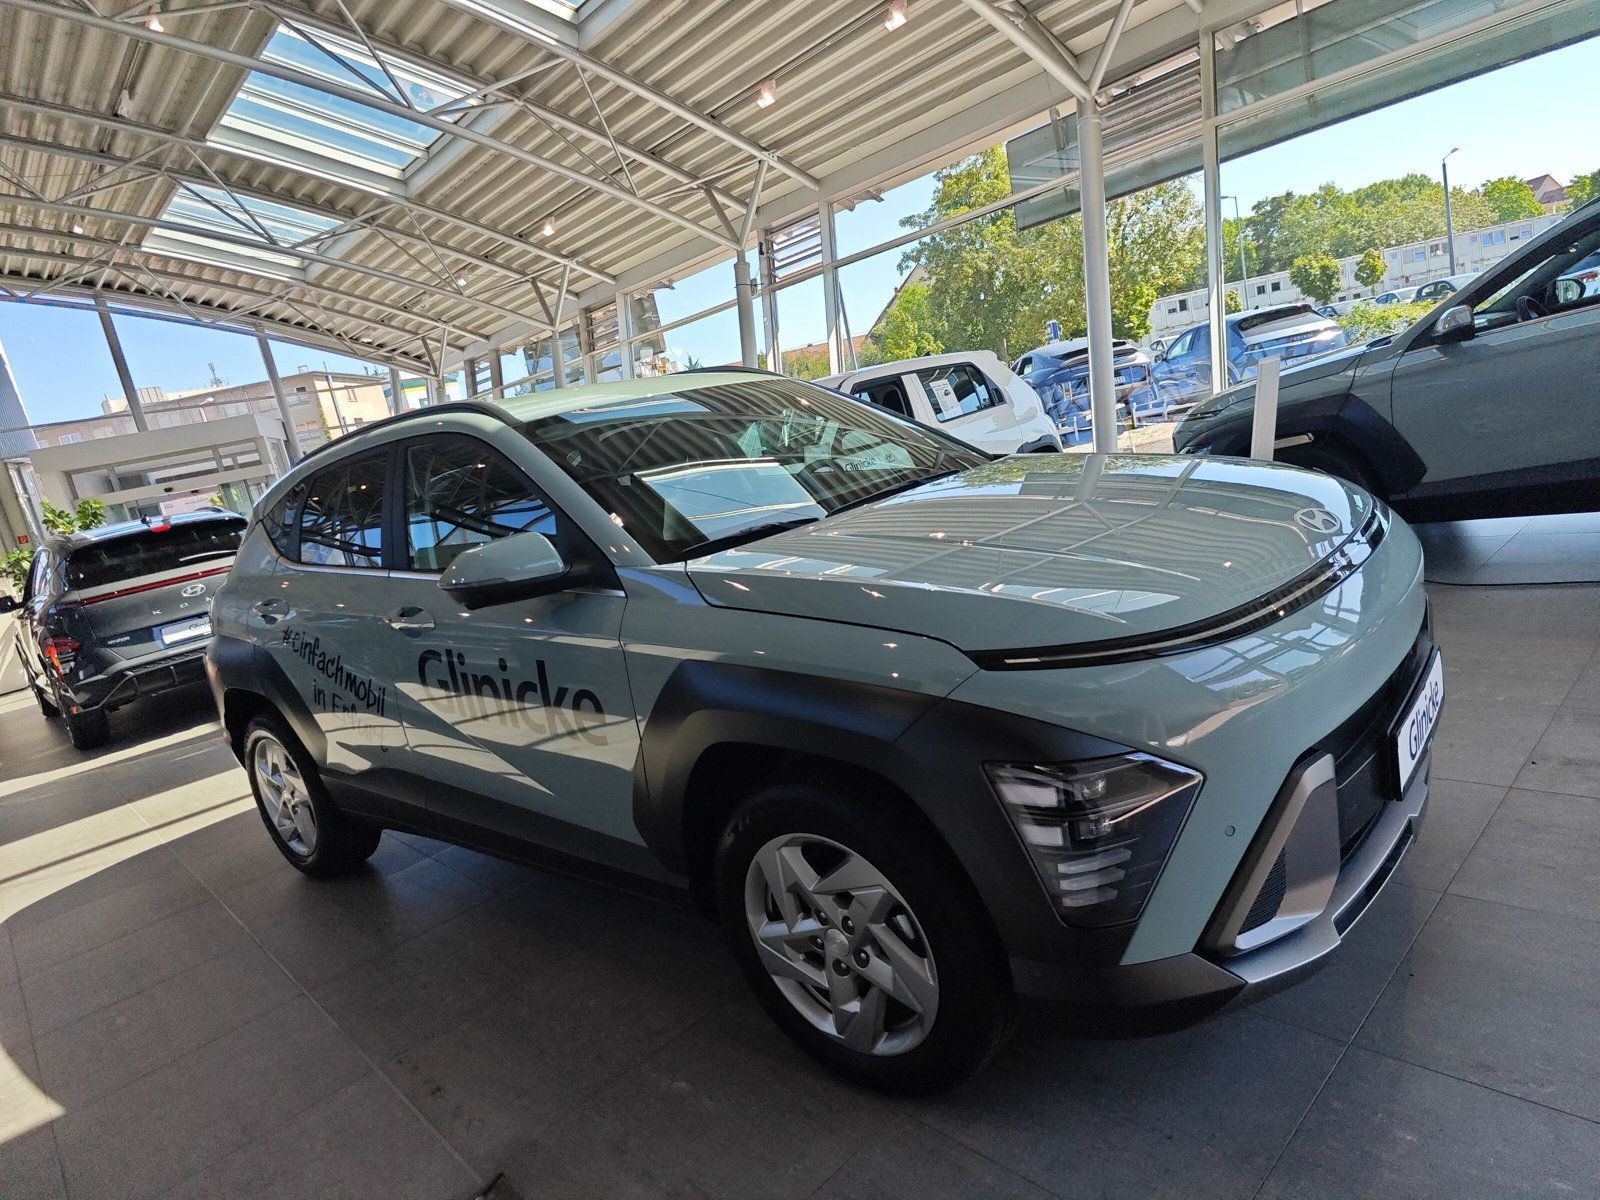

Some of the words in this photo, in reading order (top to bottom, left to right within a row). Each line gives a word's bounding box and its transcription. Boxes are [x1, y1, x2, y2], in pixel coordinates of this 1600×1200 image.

[844, 457, 877, 472] Glinicke
[313, 679, 326, 711] in
[418, 649, 609, 747] Glinicke
[1409, 680, 1439, 761] Glinicke
